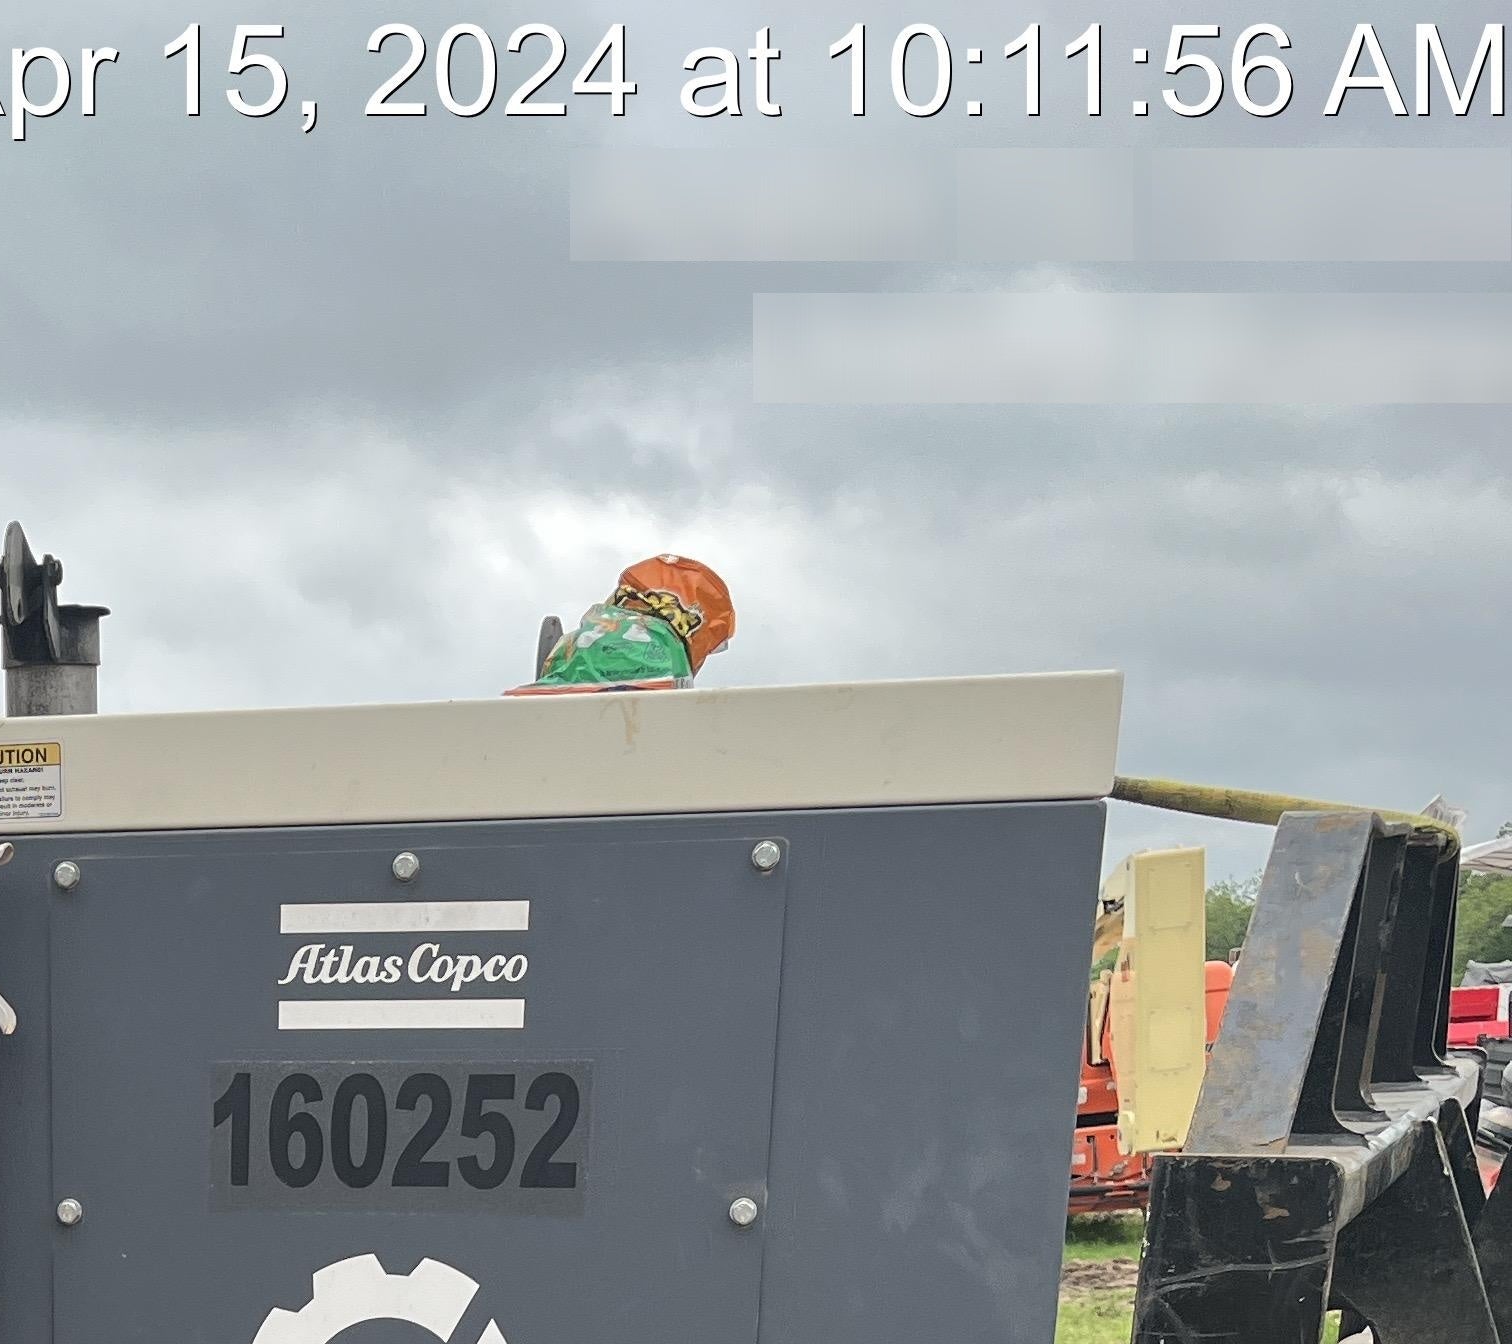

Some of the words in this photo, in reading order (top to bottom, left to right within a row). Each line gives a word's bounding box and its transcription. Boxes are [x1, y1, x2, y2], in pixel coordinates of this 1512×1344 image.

[277, 942, 403, 985] Atlas
[407, 942, 528, 992] Copco
[212, 1072, 581, 1190] 160252
